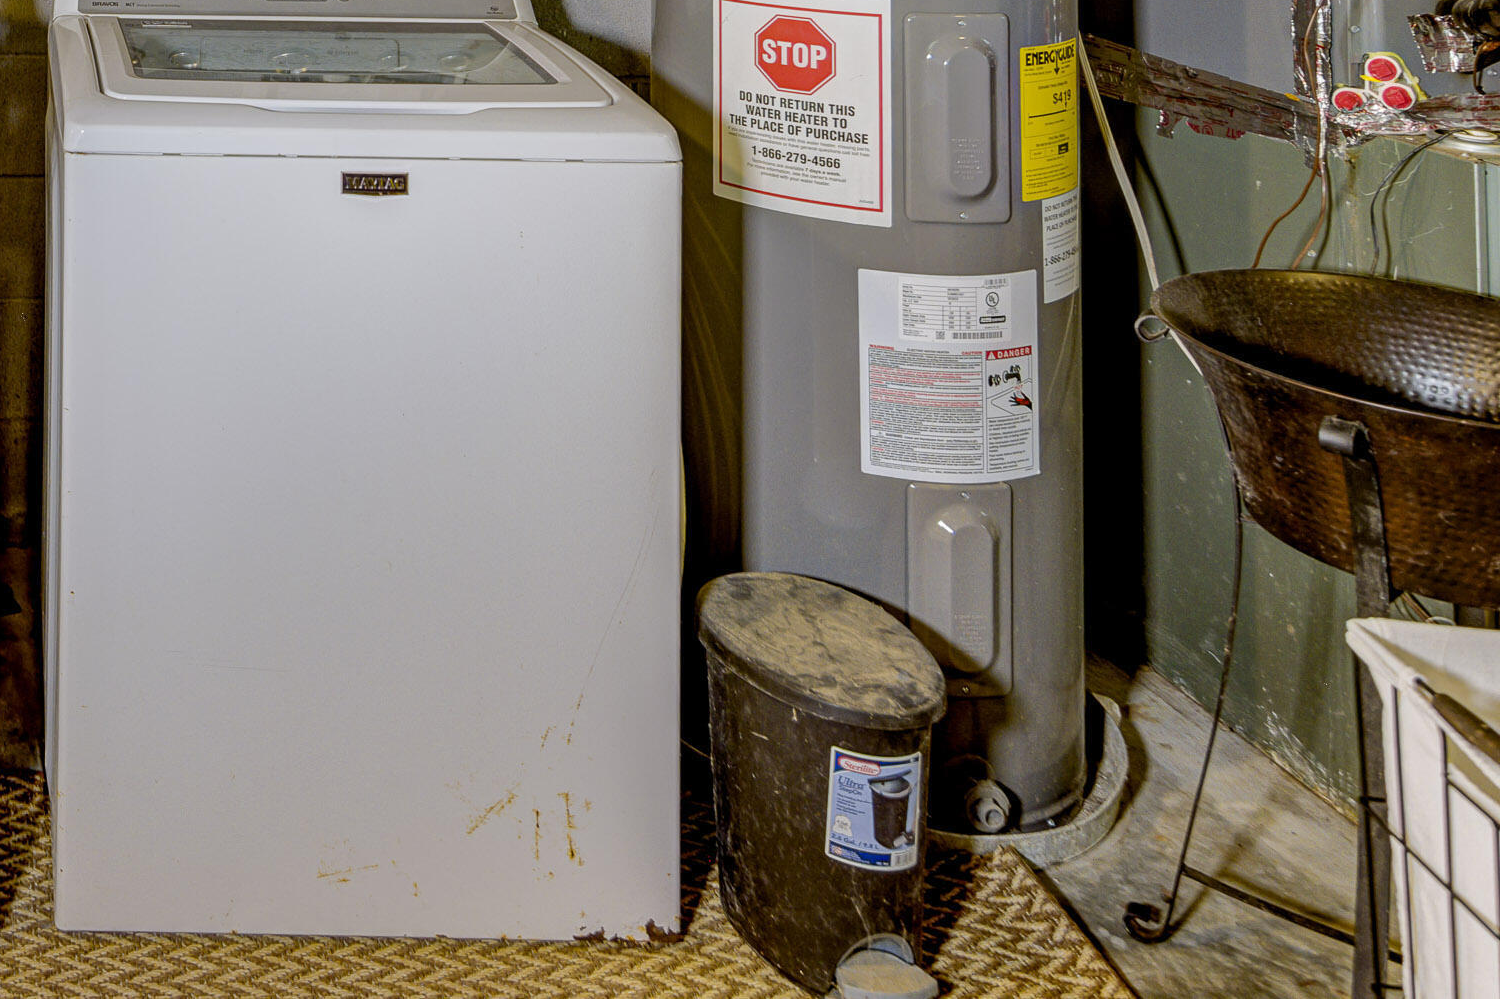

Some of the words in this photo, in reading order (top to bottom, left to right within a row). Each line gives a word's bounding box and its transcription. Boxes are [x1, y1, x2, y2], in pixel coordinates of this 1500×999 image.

[762, 38, 827, 70] STOP
[739, 90, 753, 102] DO
[756, 93, 776, 107] NOT
[780, 97, 824, 113] RETURN
[828, 104, 856, 117] THIS
[745, 104, 781, 120] WATER
[784, 111, 828, 127] HEATER
[832, 117, 848, 129] TO
[729, 114, 748, 127] THE
[750, 118, 784, 134] PLACE
[788, 124, 802, 136] OF
[806, 127, 869, 144] PURCHASE
[752, 145, 841, 169] 1-866-279-4566
[346, 176, 405, 190] MAYTAG
[996, 347, 1030, 358] DANGER
[838, 775, 864, 790] Ultra
